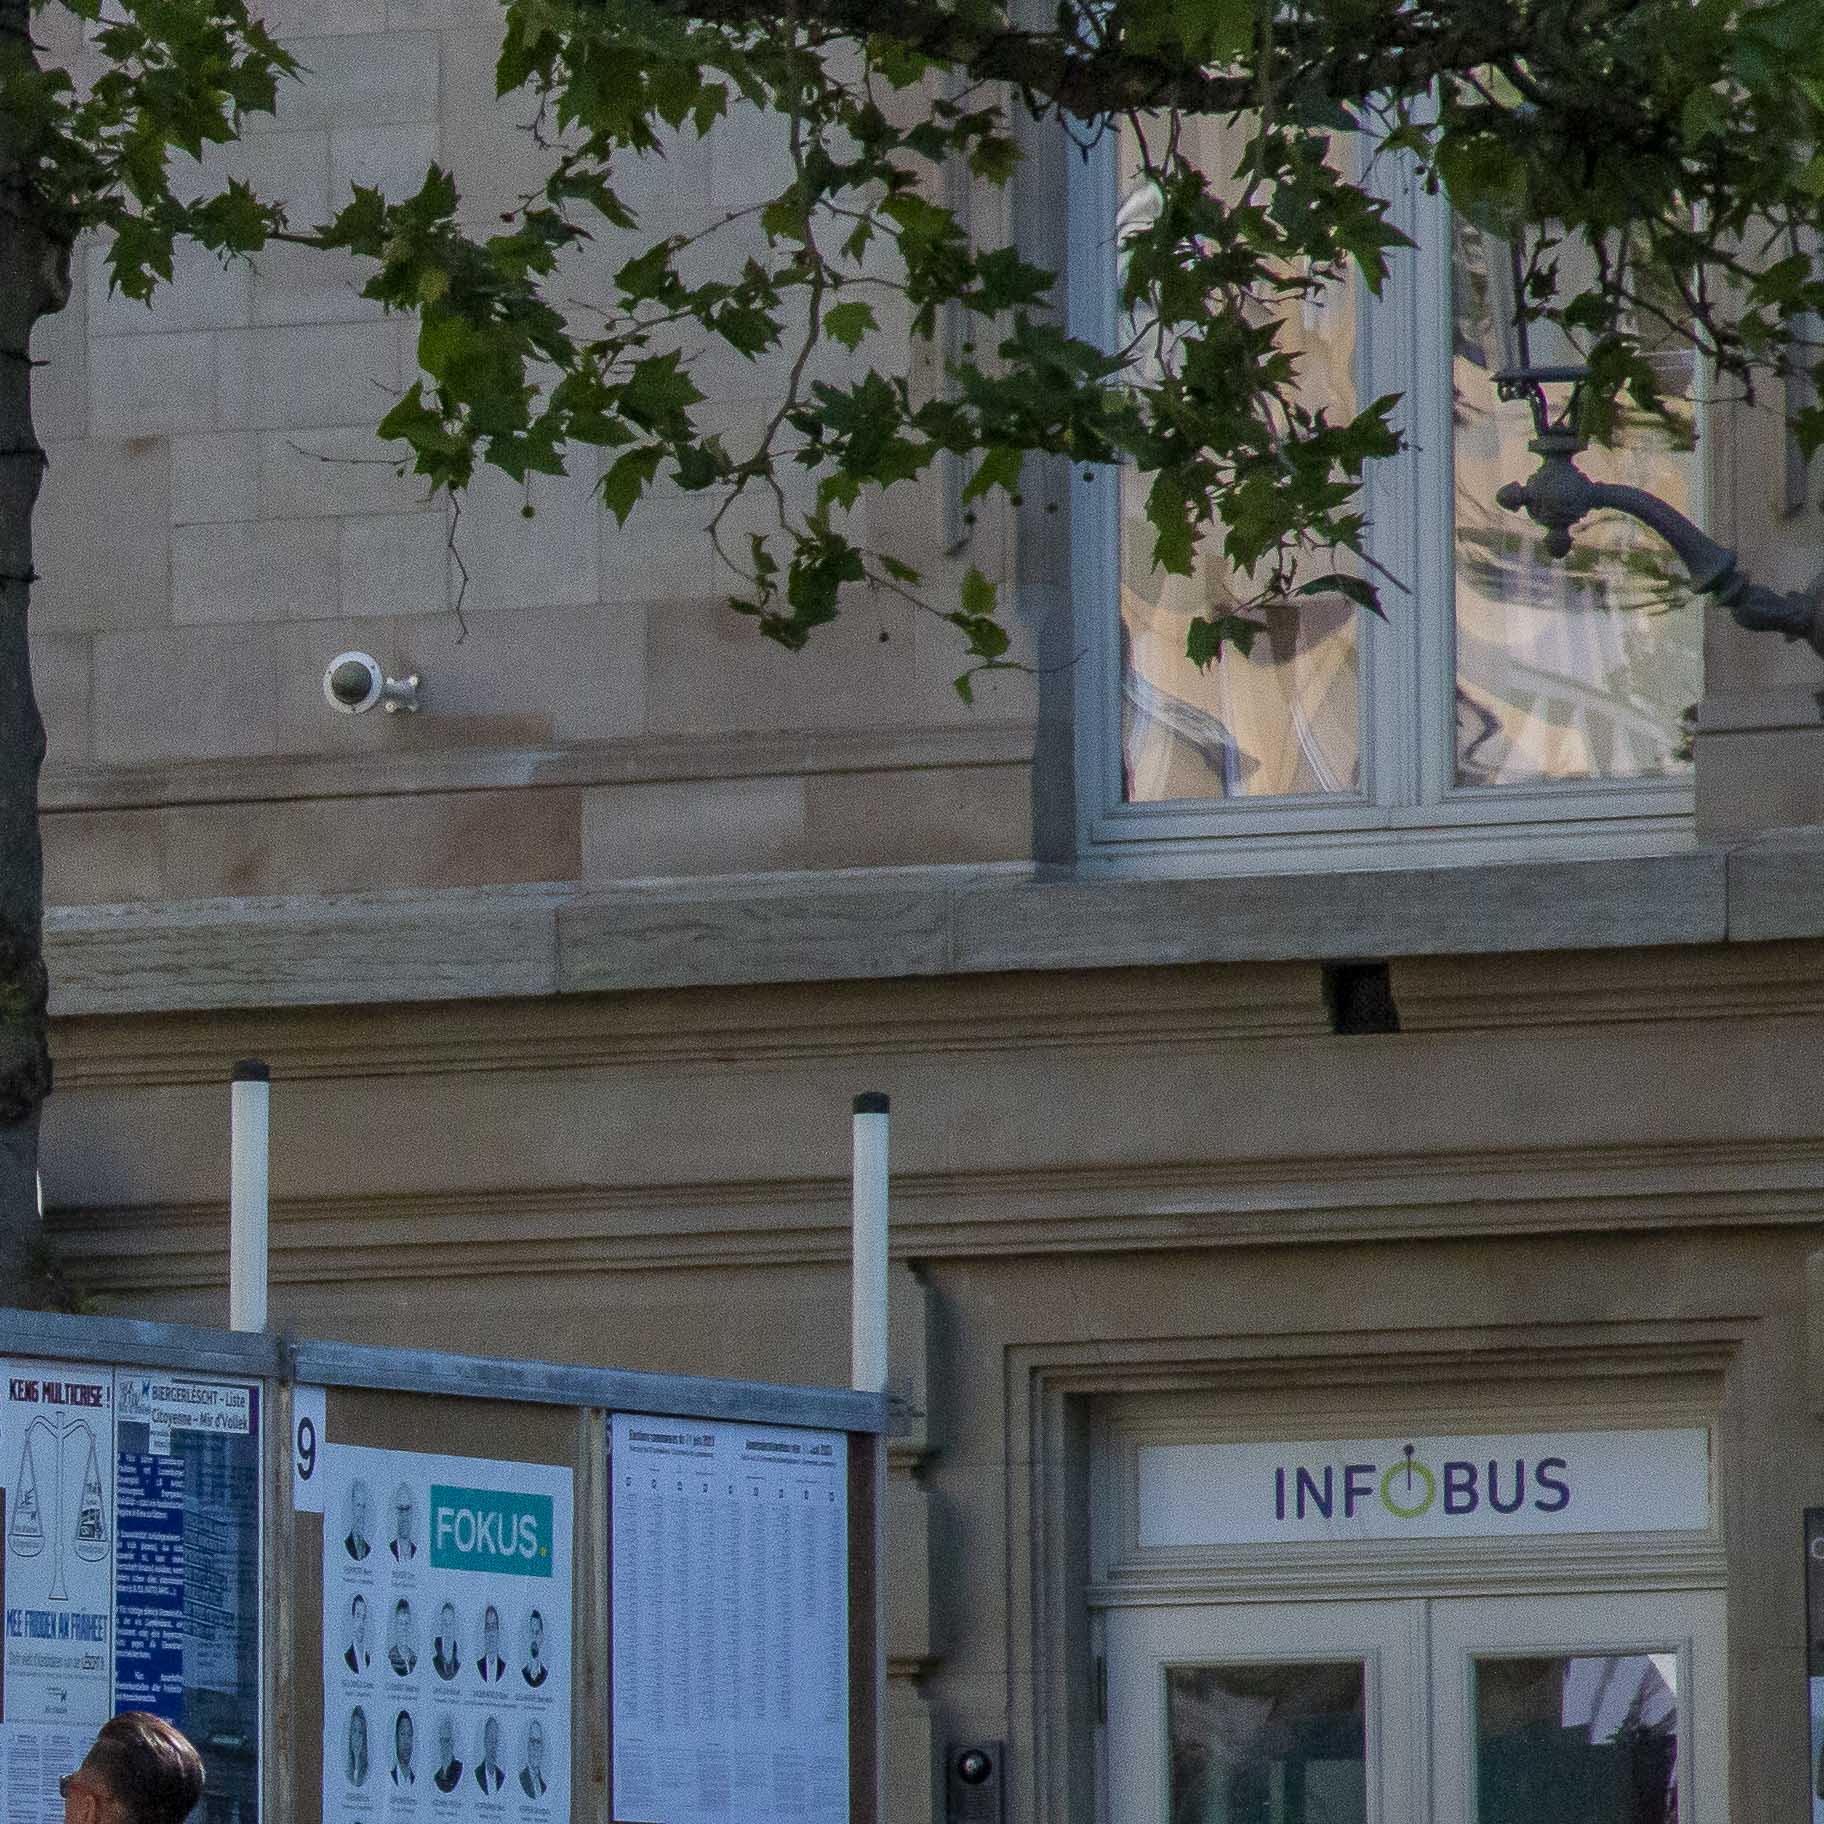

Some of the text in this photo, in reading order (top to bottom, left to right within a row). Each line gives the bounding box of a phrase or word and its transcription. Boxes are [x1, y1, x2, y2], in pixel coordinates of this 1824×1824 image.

[225, 1392, 246, 1408] Liste
[297, 1417, 316, 1481] 9
[1275, 1446, 1571, 1520] INFOBUS
